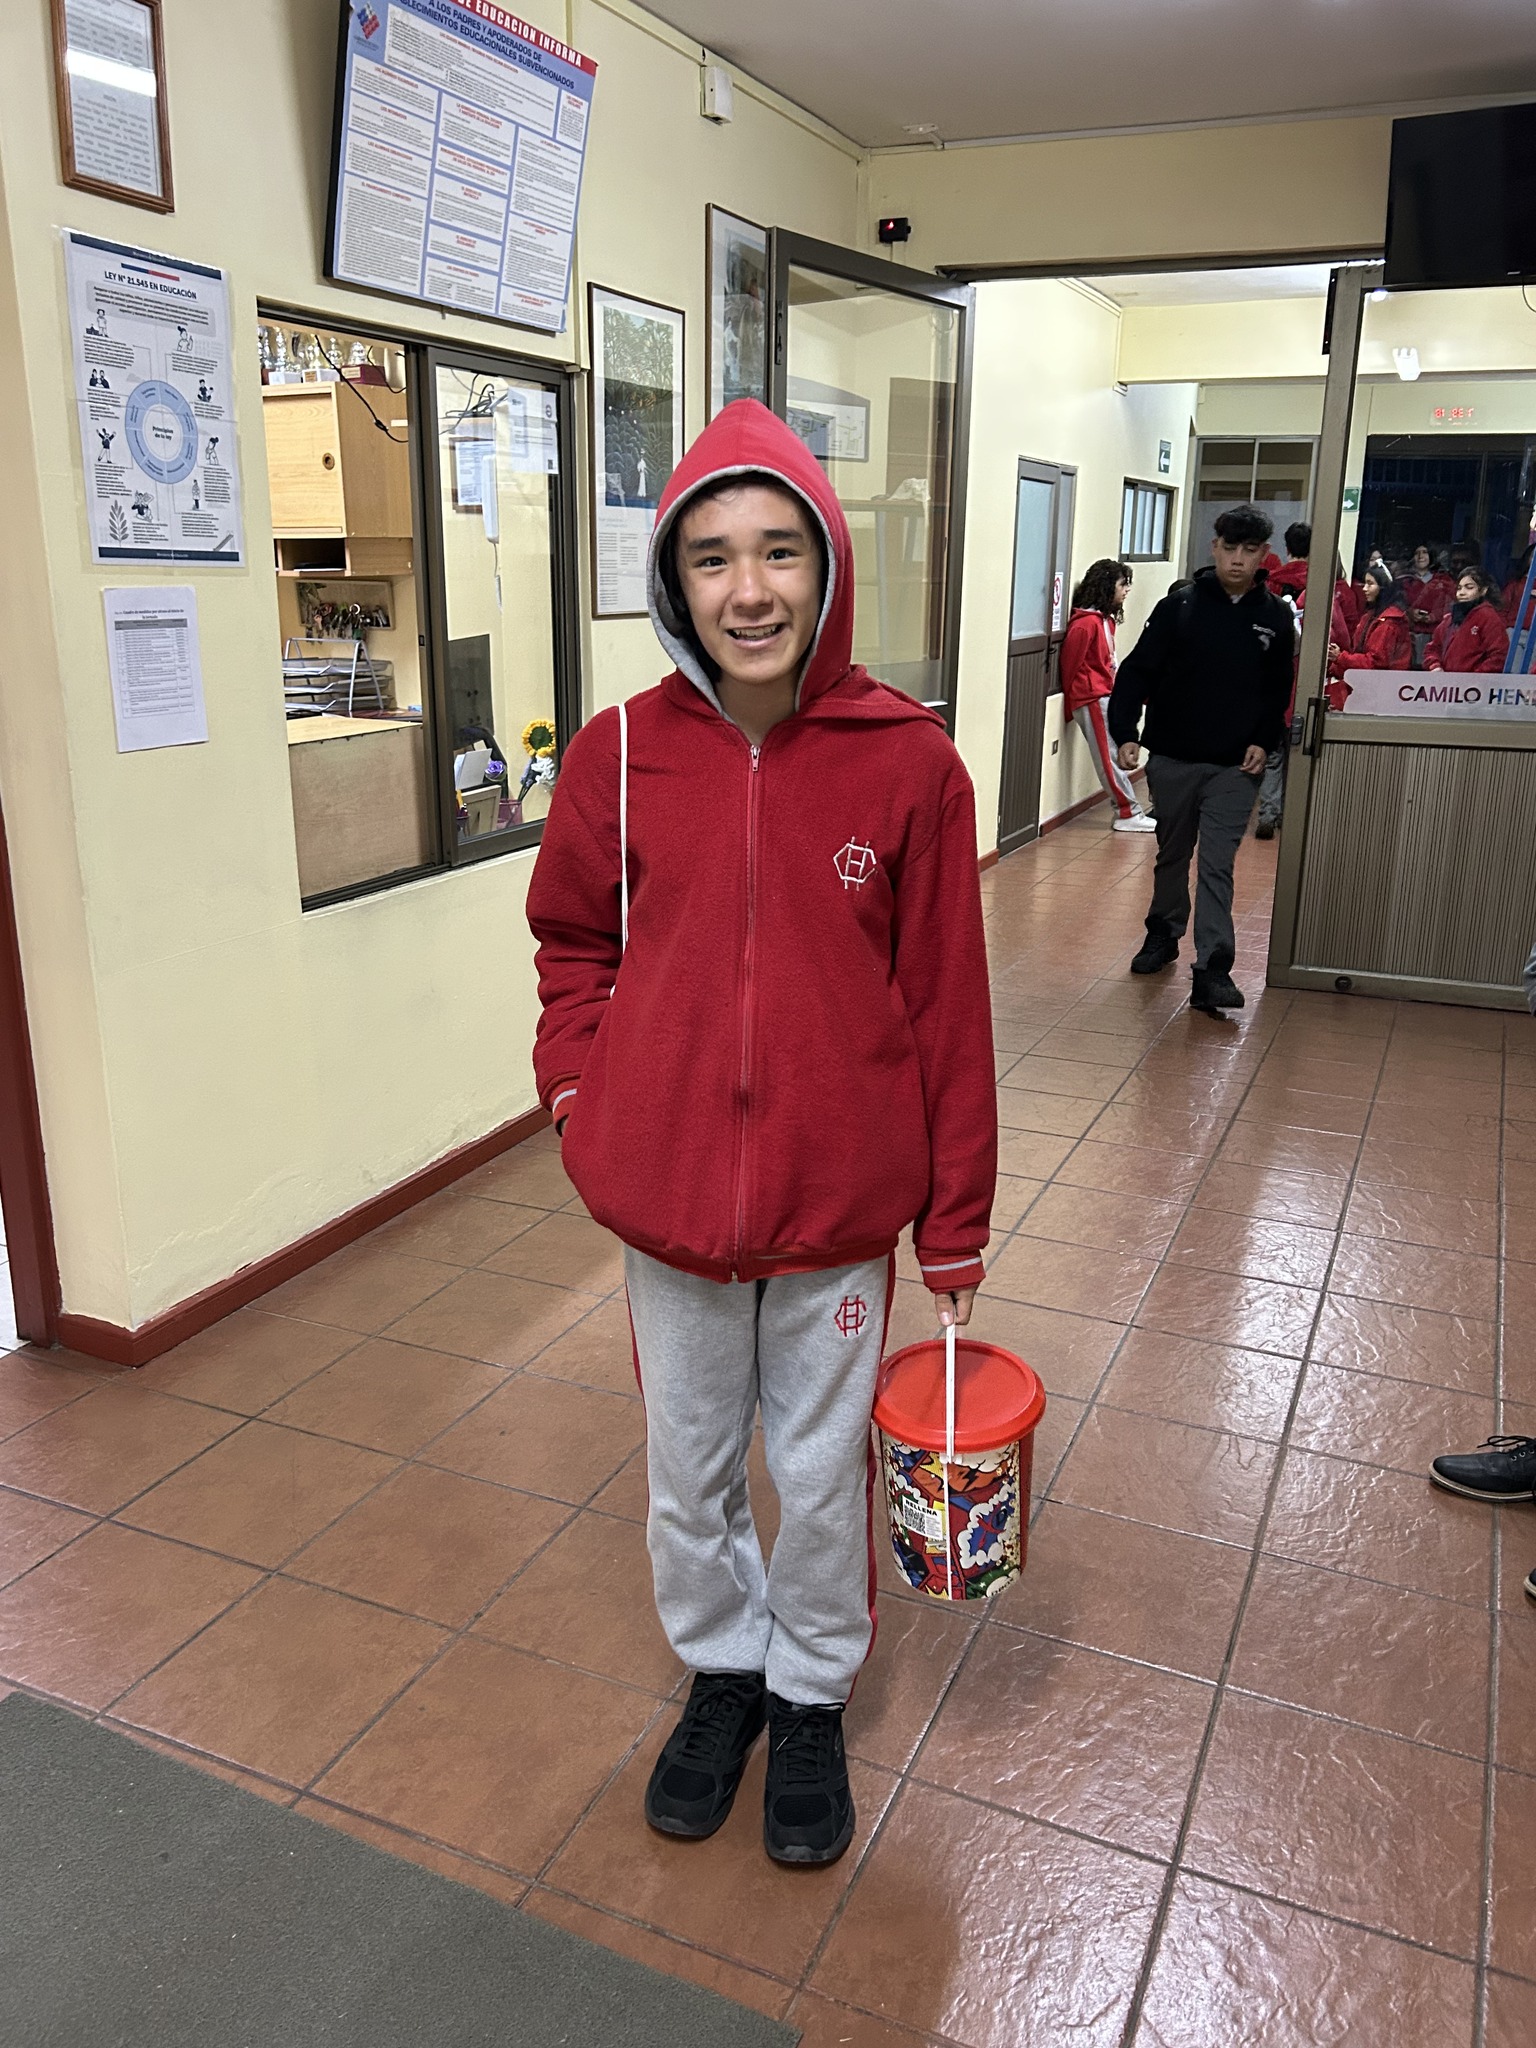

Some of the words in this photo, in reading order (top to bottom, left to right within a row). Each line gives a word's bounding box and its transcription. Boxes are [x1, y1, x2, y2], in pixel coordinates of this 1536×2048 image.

[436, 1, 452, 16] LOS
[453, 10, 482, 31] PADRES
[482, 24, 488, 33] Y
[487, 27, 533, 58] APODERADOS
[533, 51, 542, 62] DE
[475, 0, 537, 43] EDUCACION
[539, 34, 583, 67] INFORMA
[460, 20, 518, 60] EDUCACIONALES
[518, 55, 575, 90] SUBVENCIONADOS
[104, 271, 116, 280] LEY
[127, 276, 148, 289] 21.545
[150, 282, 159, 291] EN
[160, 285, 197, 299] EDUCACIÓN
[1398, 685, 1481, 704] CAMILO
[905, 1499, 938, 1516] RELLENA
